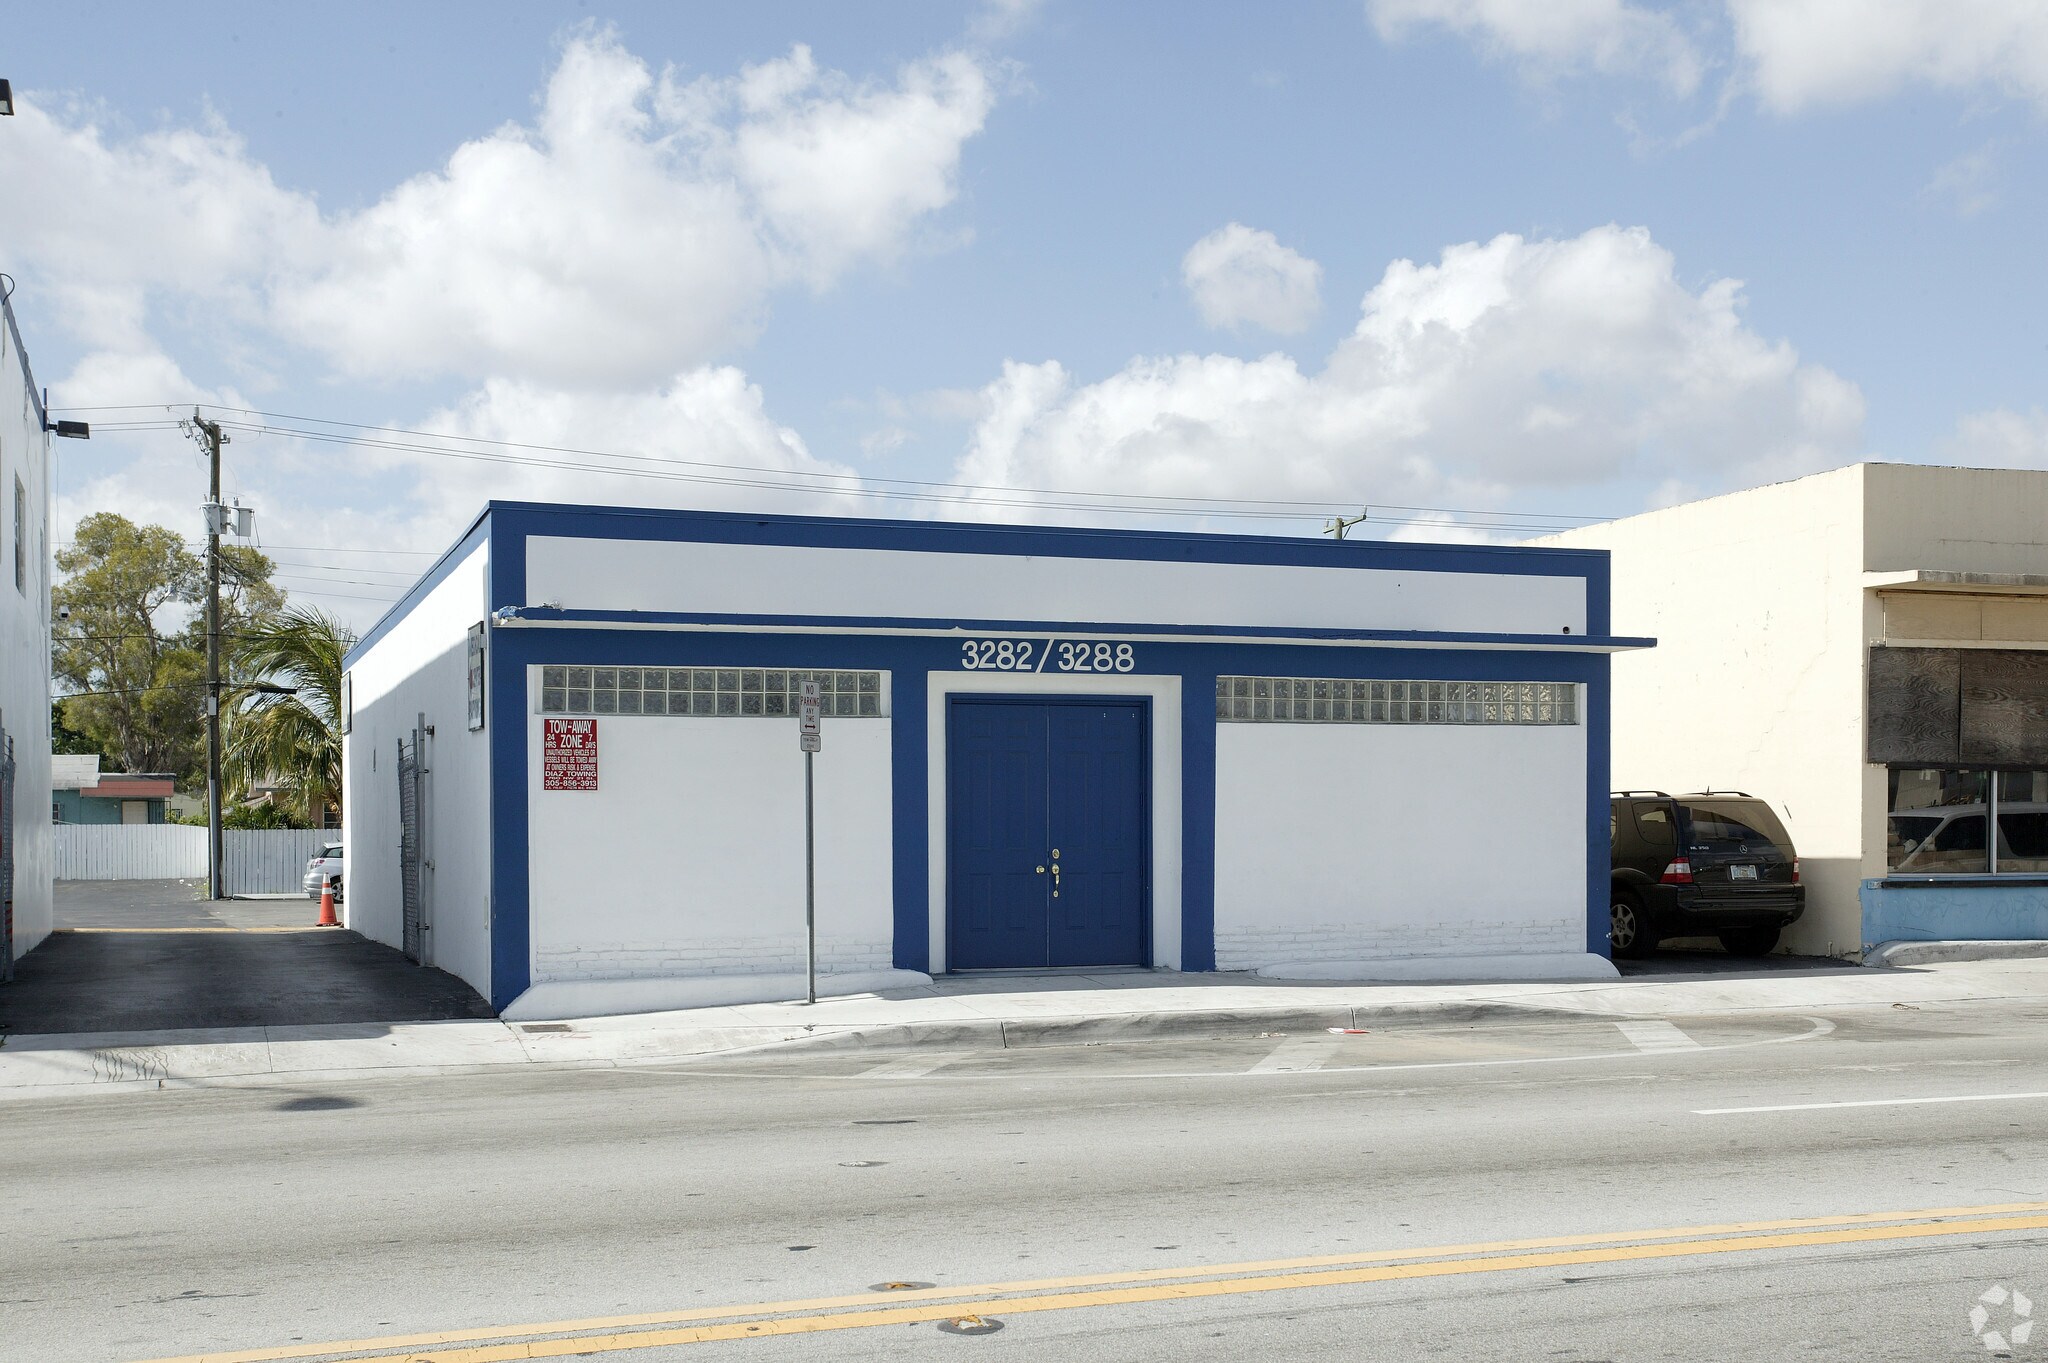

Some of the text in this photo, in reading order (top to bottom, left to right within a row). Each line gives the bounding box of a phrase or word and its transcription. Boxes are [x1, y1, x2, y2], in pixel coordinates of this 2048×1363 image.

[805, 684, 815, 695] NO
[800, 696, 820, 707] PARKING
[549, 720, 592, 734] TOW-AWAY
[545, 741, 557, 749] HRS
[560, 734, 583, 748] ZONE
[585, 741, 596, 749] DAYS
